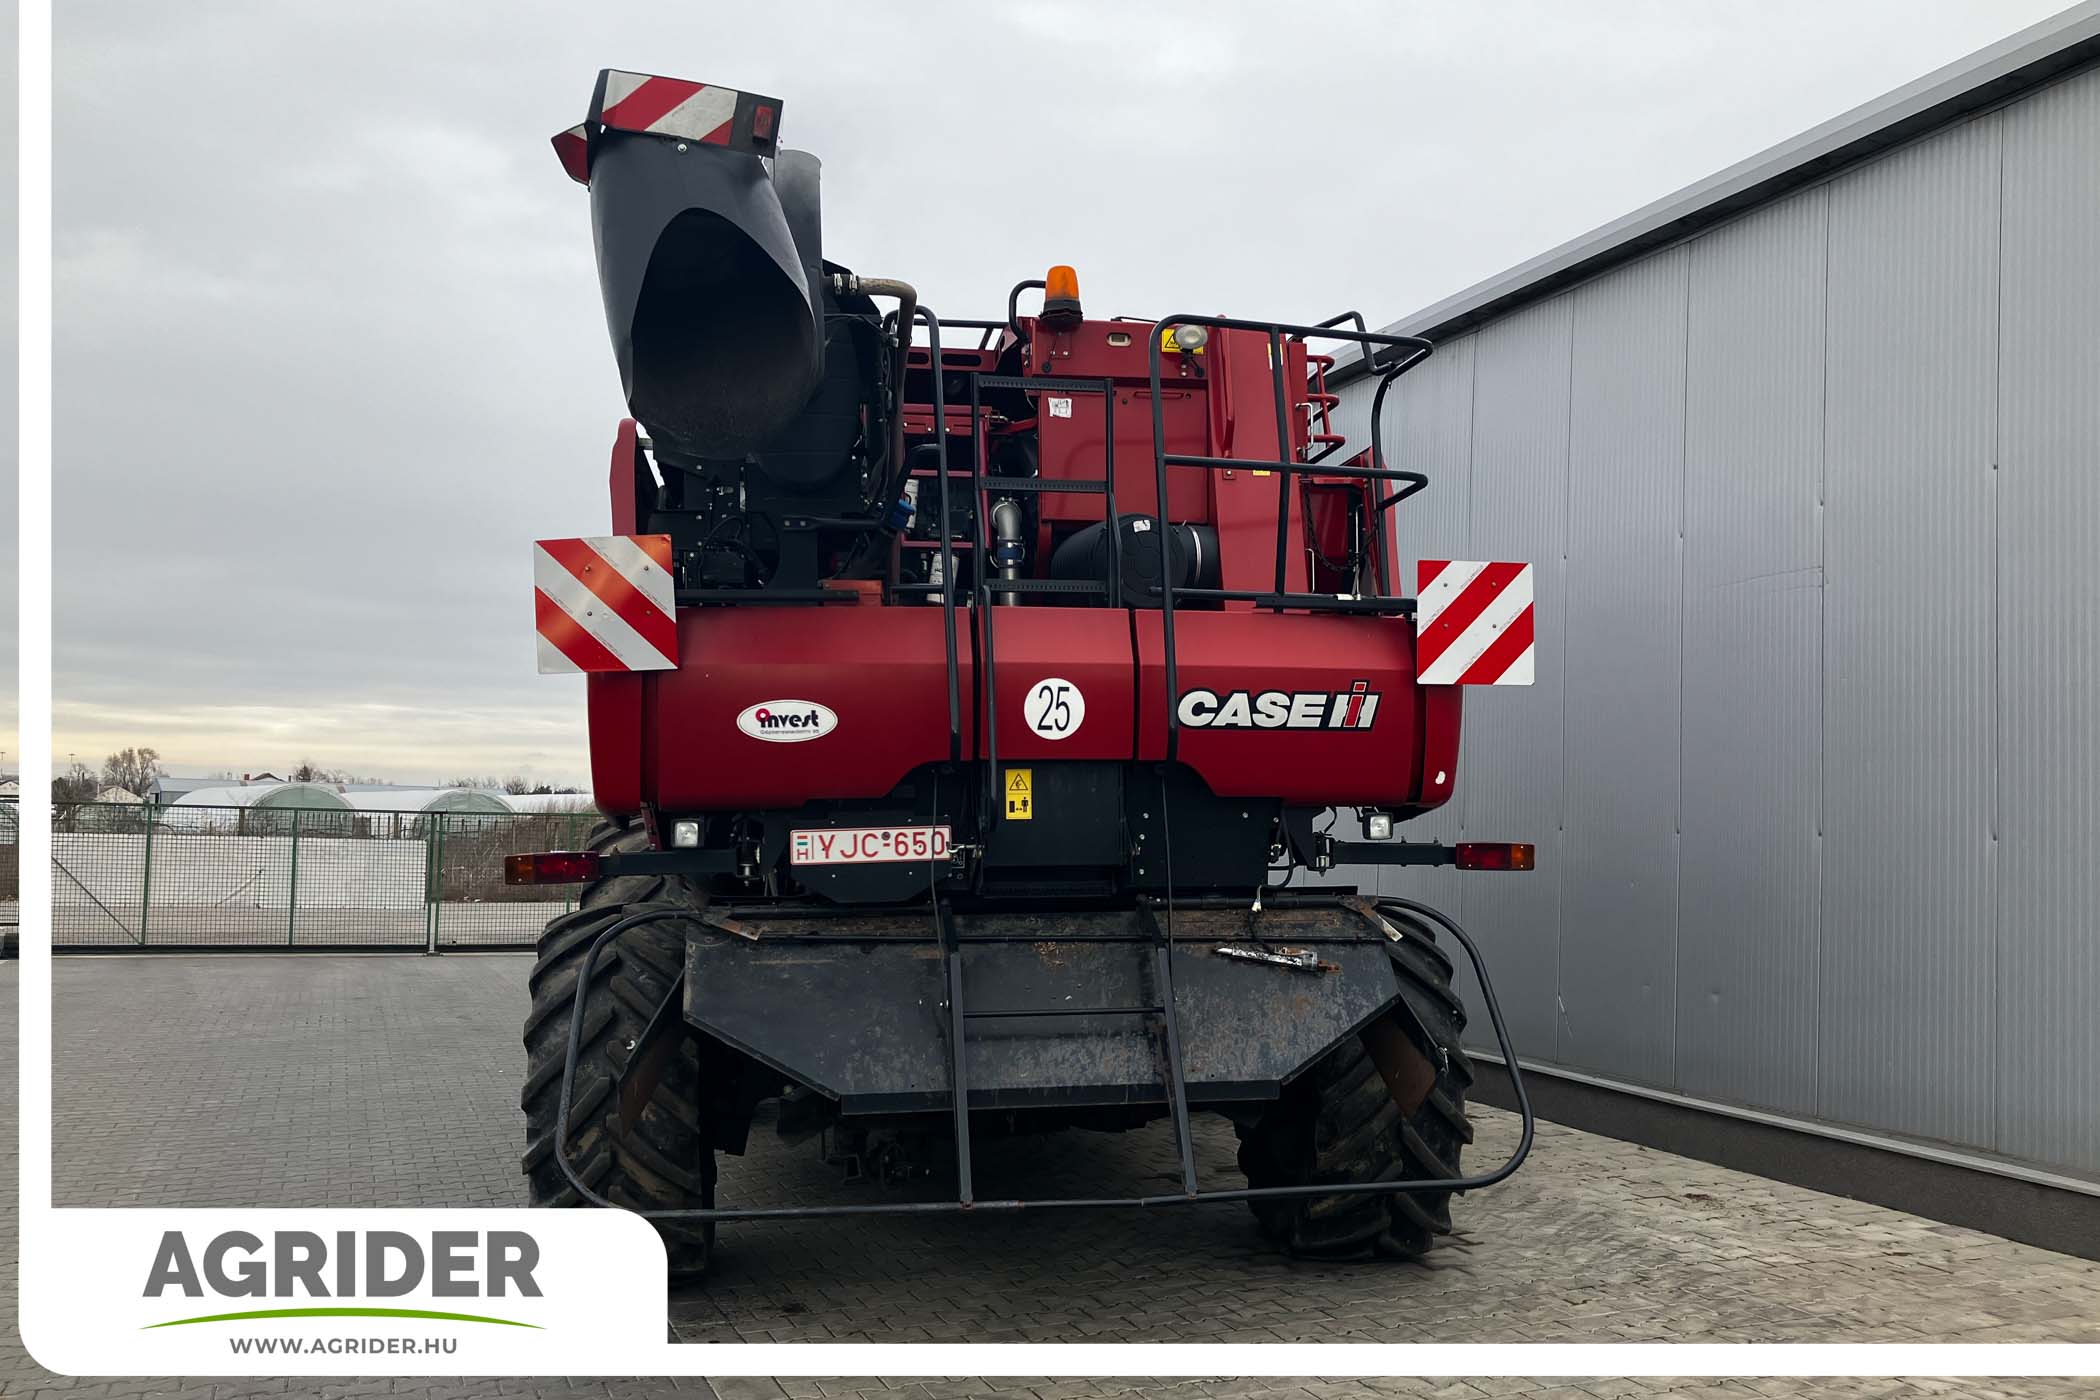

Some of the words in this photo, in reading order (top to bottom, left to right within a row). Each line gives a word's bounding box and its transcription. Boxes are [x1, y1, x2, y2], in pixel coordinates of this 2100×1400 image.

[756, 708, 819, 728] invest
[1038, 686, 1070, 730] 25
[1178, 691, 1327, 727] CASE
